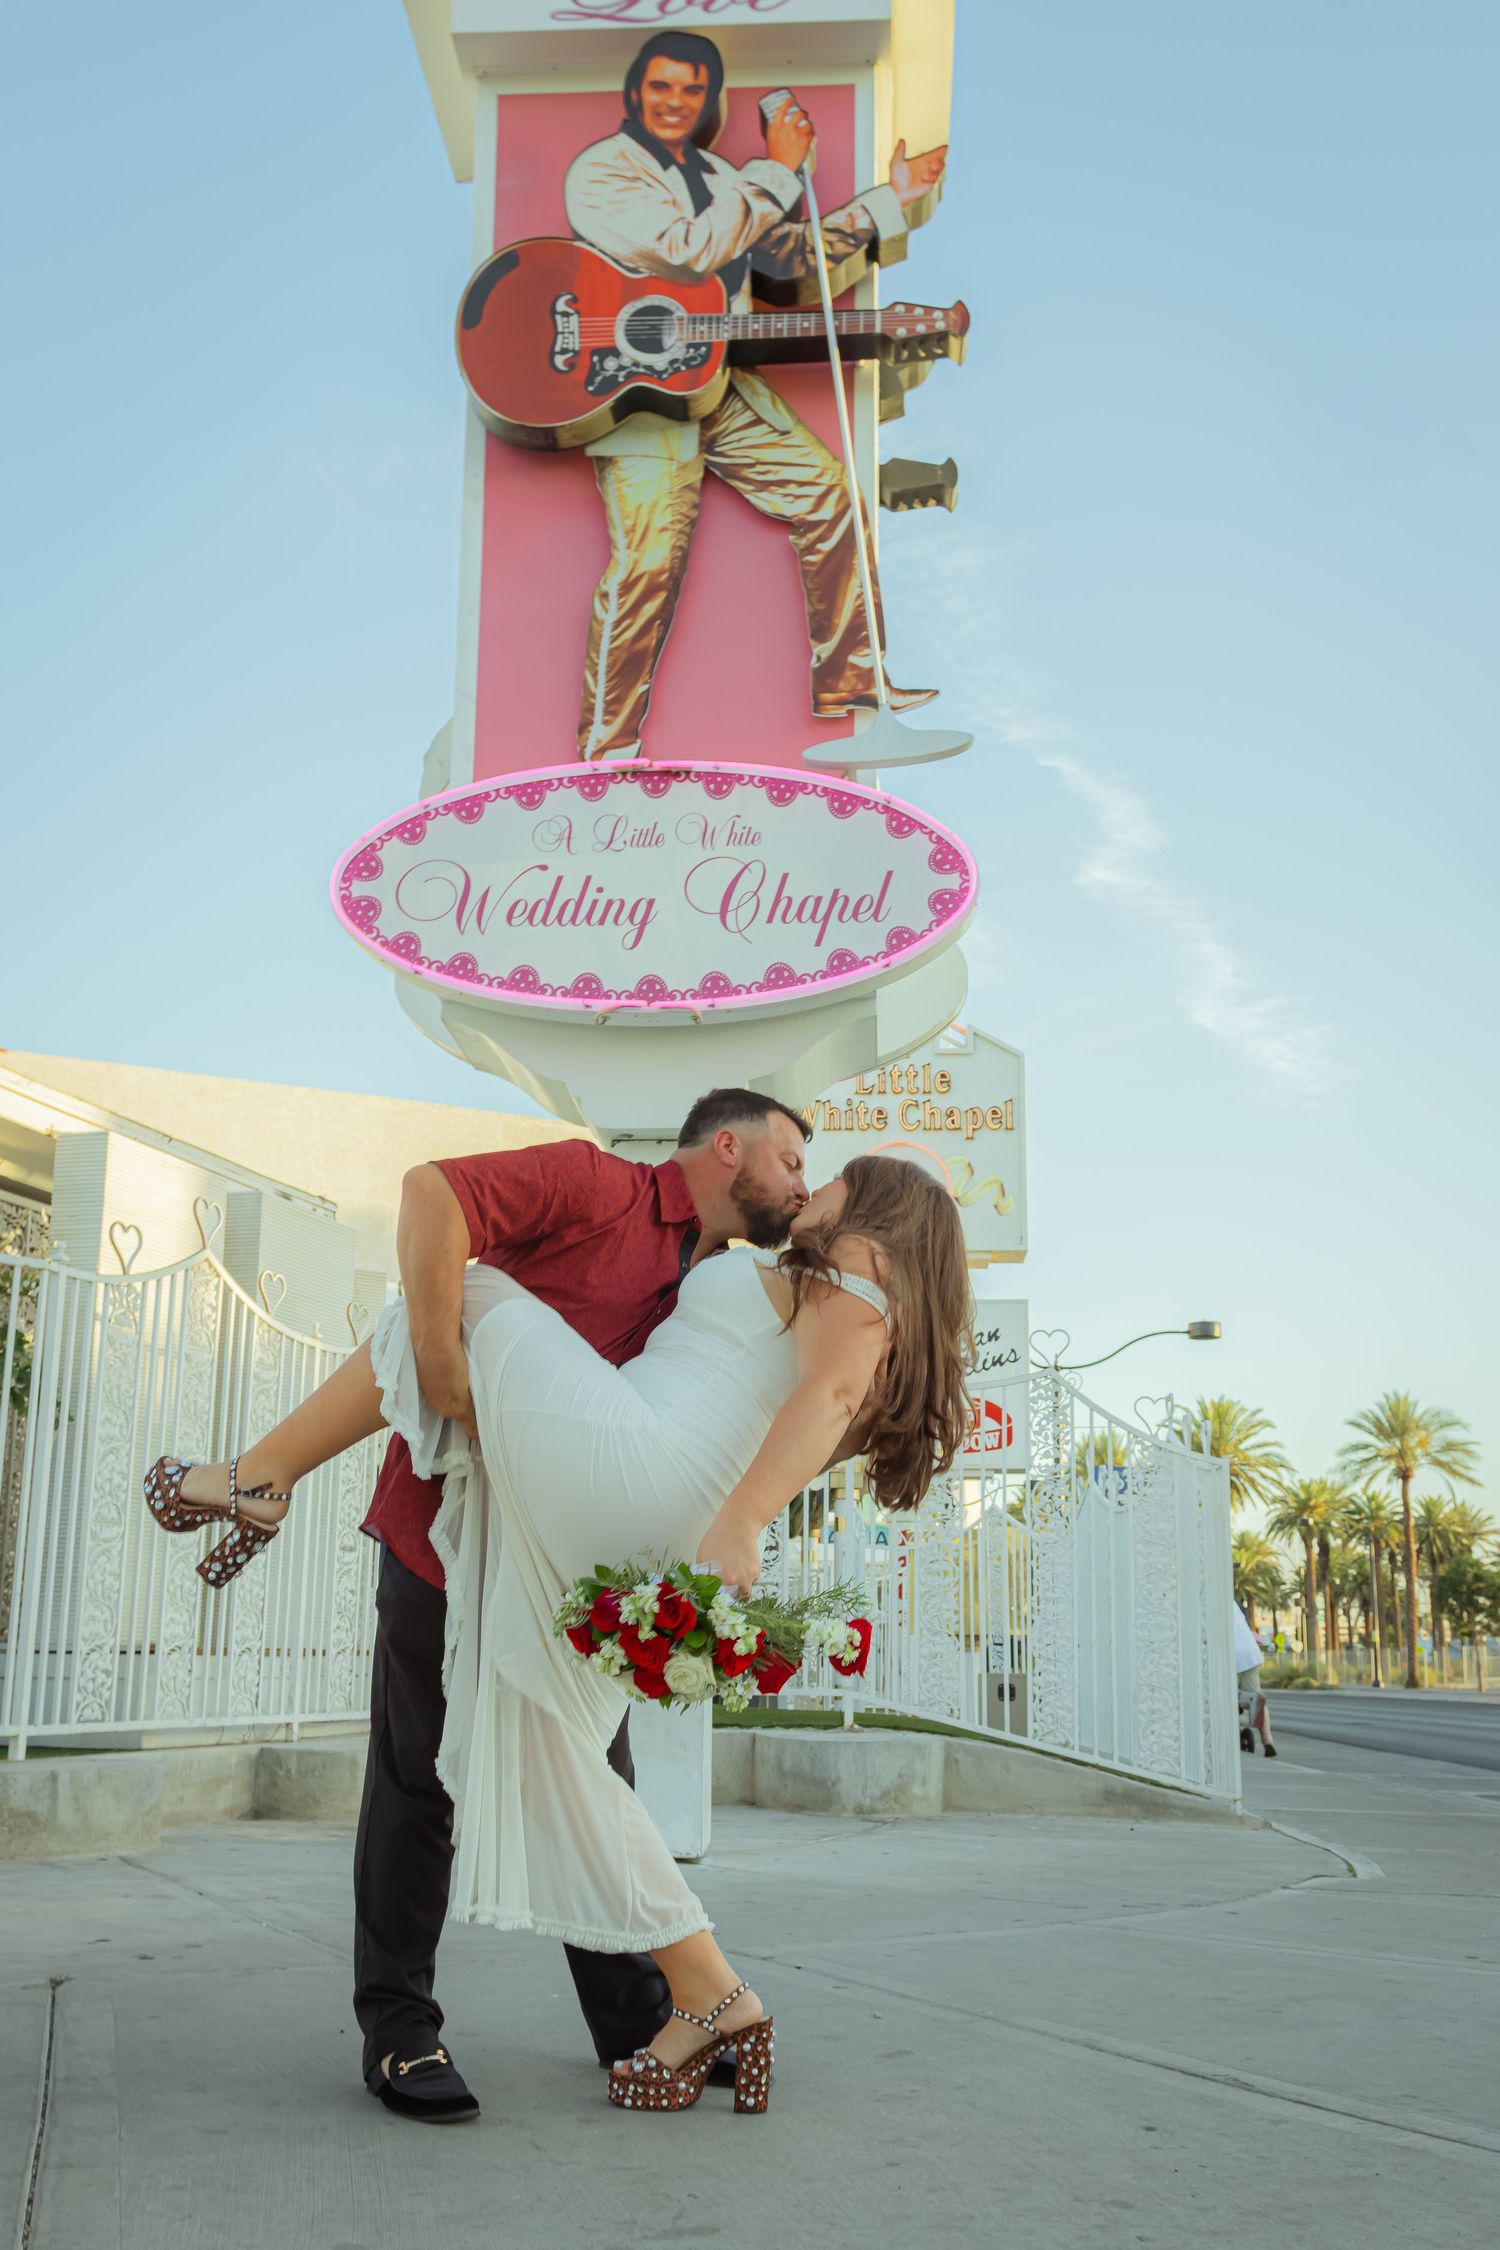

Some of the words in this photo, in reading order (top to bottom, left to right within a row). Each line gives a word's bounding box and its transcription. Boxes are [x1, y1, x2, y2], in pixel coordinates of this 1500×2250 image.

[532, 814, 578, 856] A
[591, 813, 666, 853] Little
[675, 812, 763, 851] White
[395, 859, 658, 951] Wedding
[684, 856, 894, 947] Chapel
[855, 1064, 951, 1095] Little
[899, 1099, 1014, 1139] Chapel
